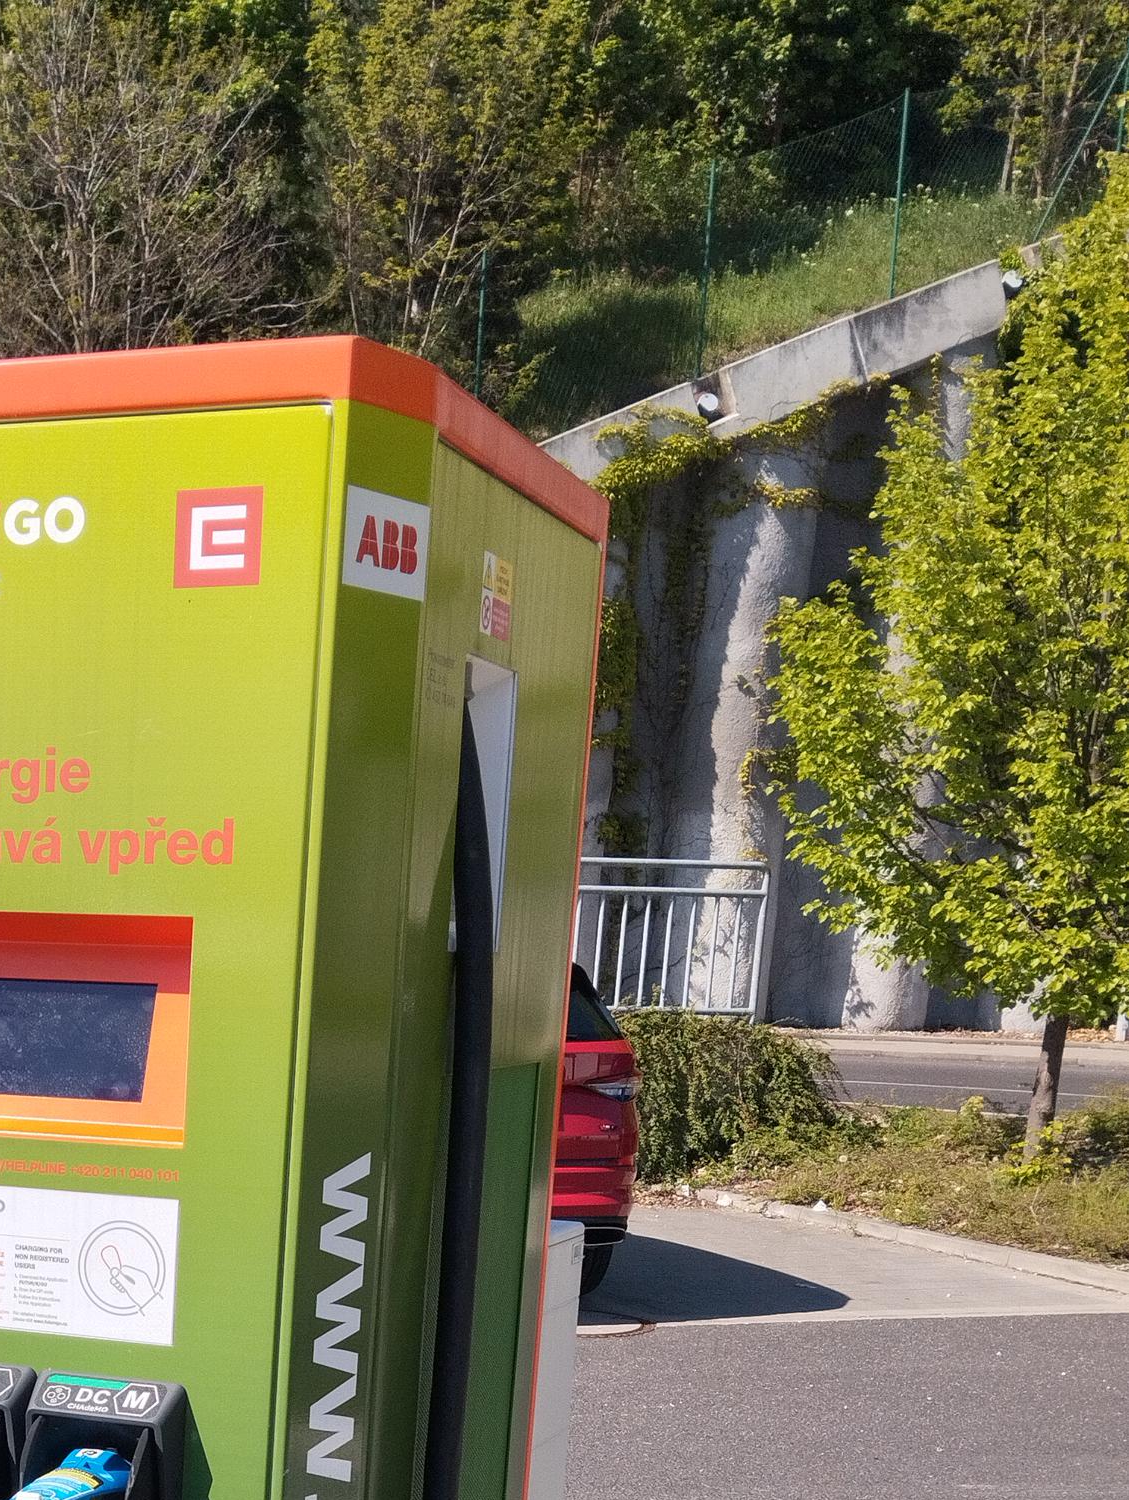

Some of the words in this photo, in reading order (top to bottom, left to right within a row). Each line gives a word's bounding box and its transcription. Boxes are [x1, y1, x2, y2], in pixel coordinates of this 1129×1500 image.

[355, 514, 418, 575] ABB
[79, 816, 235, 875] vpřed
[75, 1387, 111, 1405] DC
[122, 1390, 151, 1410] M
